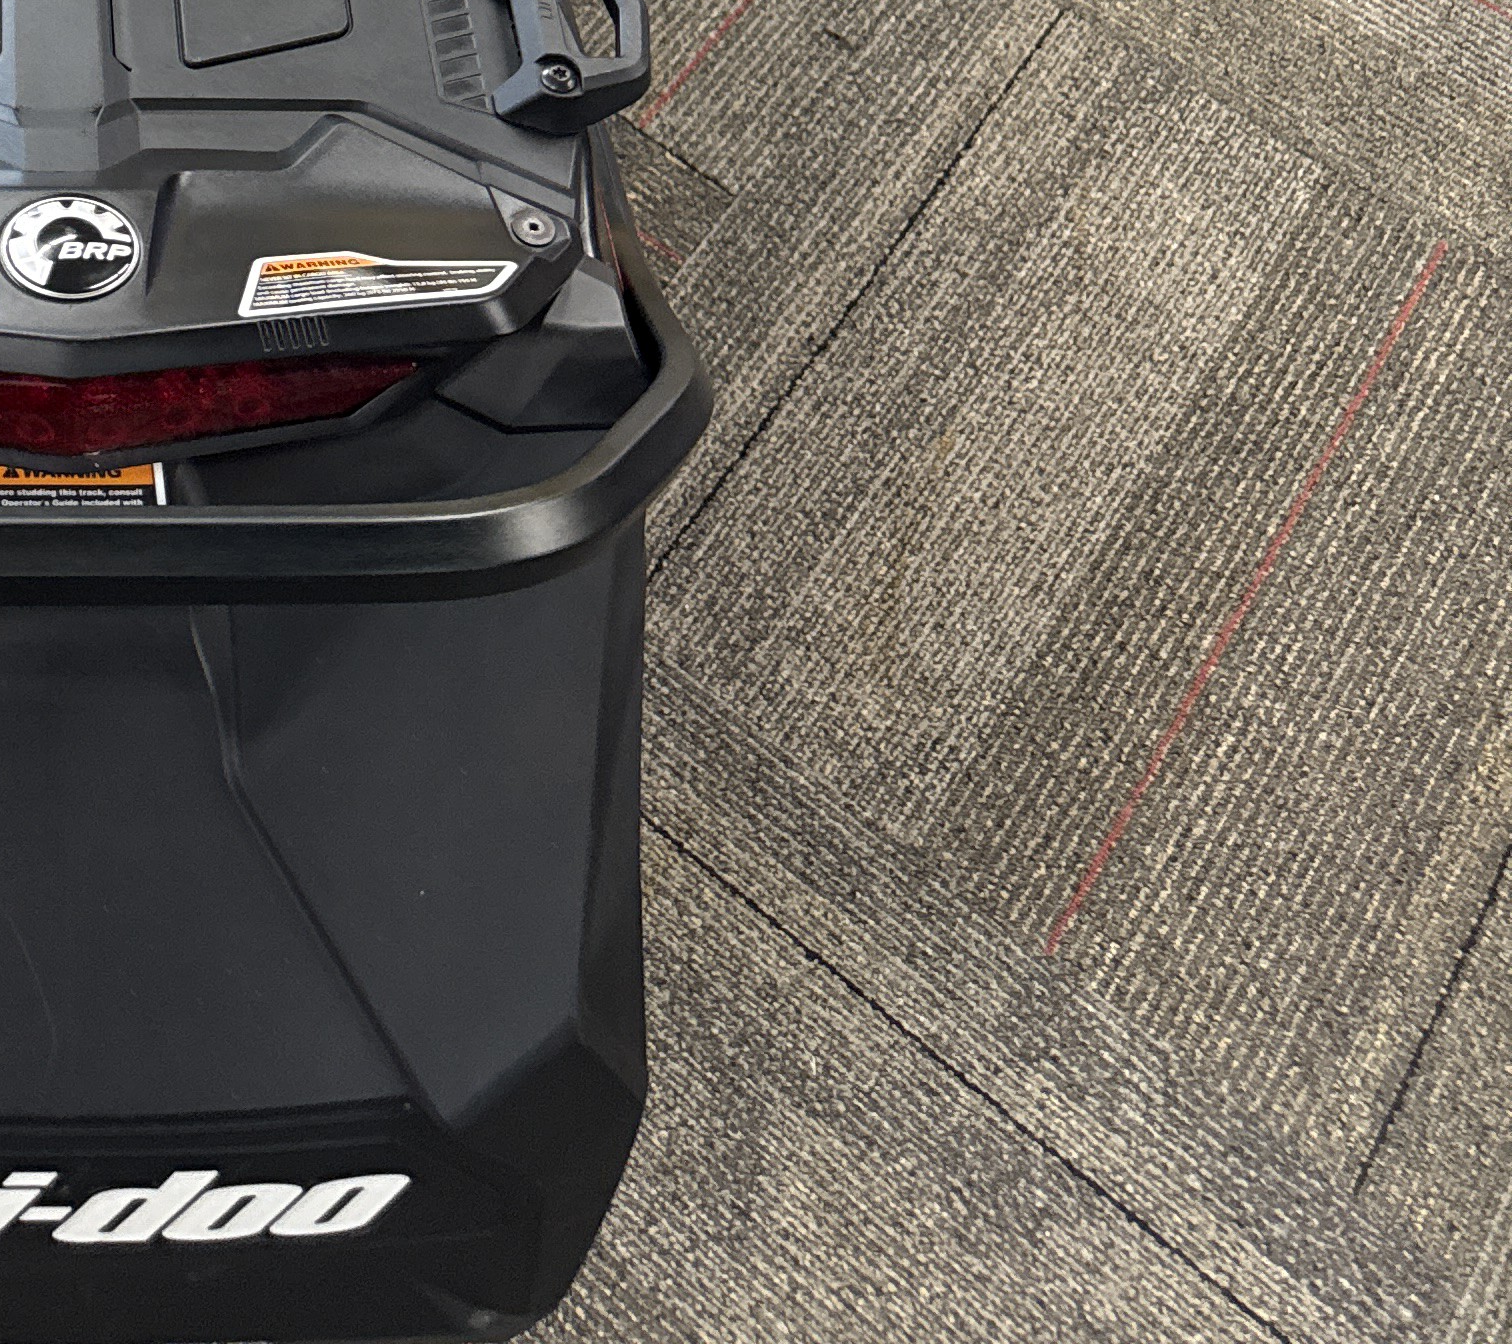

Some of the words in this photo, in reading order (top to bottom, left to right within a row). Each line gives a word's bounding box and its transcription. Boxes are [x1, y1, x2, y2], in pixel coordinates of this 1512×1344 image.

[58, 241, 133, 261] BRP
[280, 258, 361, 271] WARNING
[17, 487, 57, 498] studding
[59, 487, 76, 496] this
[78, 488, 107, 497] track,
[108, 488, 143, 496] consult
